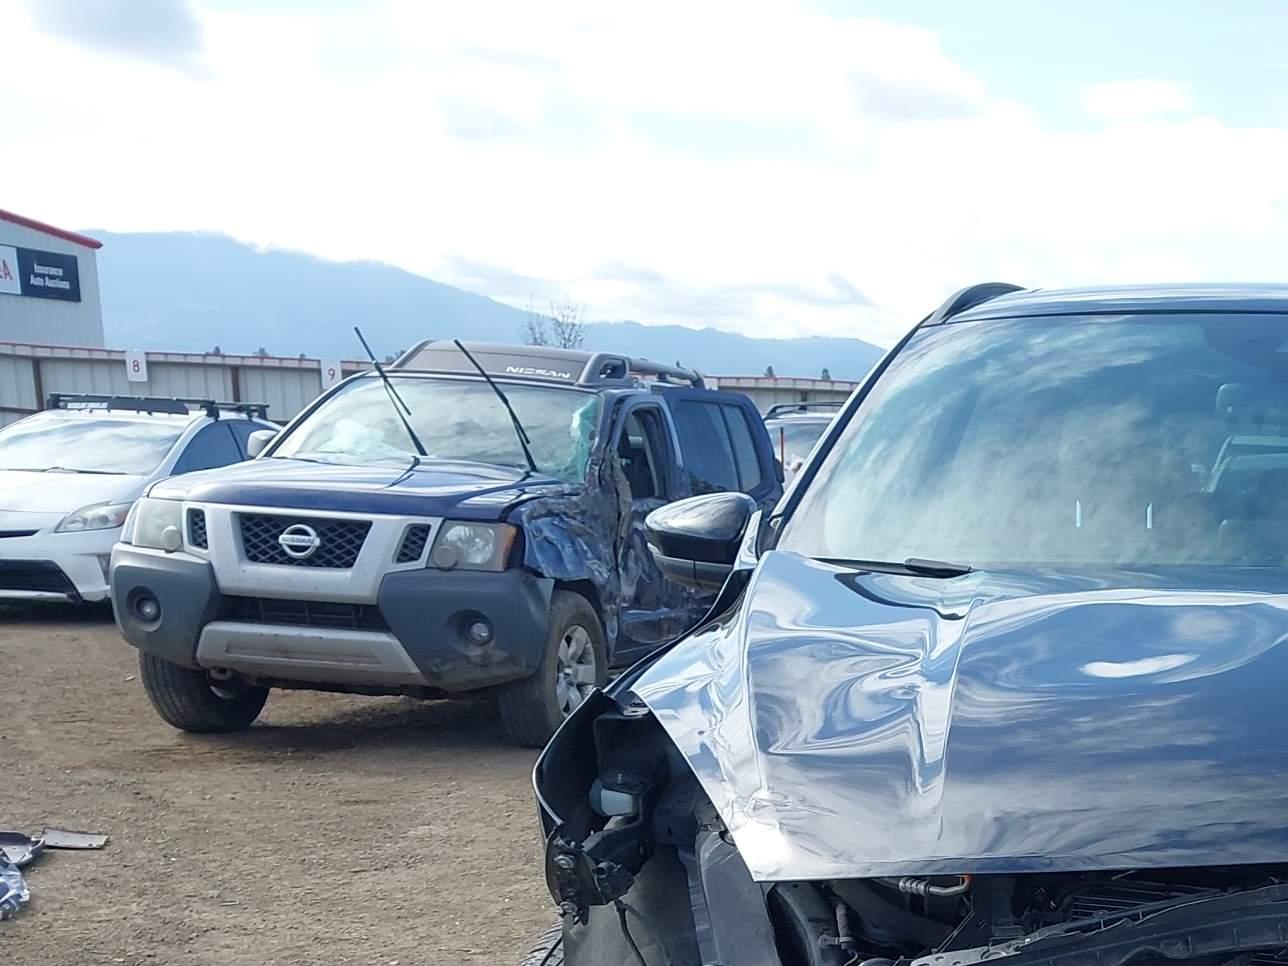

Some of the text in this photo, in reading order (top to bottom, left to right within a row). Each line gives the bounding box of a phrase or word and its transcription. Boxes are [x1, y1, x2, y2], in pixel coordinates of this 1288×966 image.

[33, 263, 63, 276] Insurance
[30, 274, 70, 290] Auto Auctions
[132, 359, 140, 373] 8
[505, 366, 571, 379] NISSAN
[327, 367, 336, 382] 9
[281, 535, 315, 545] NISSAN
